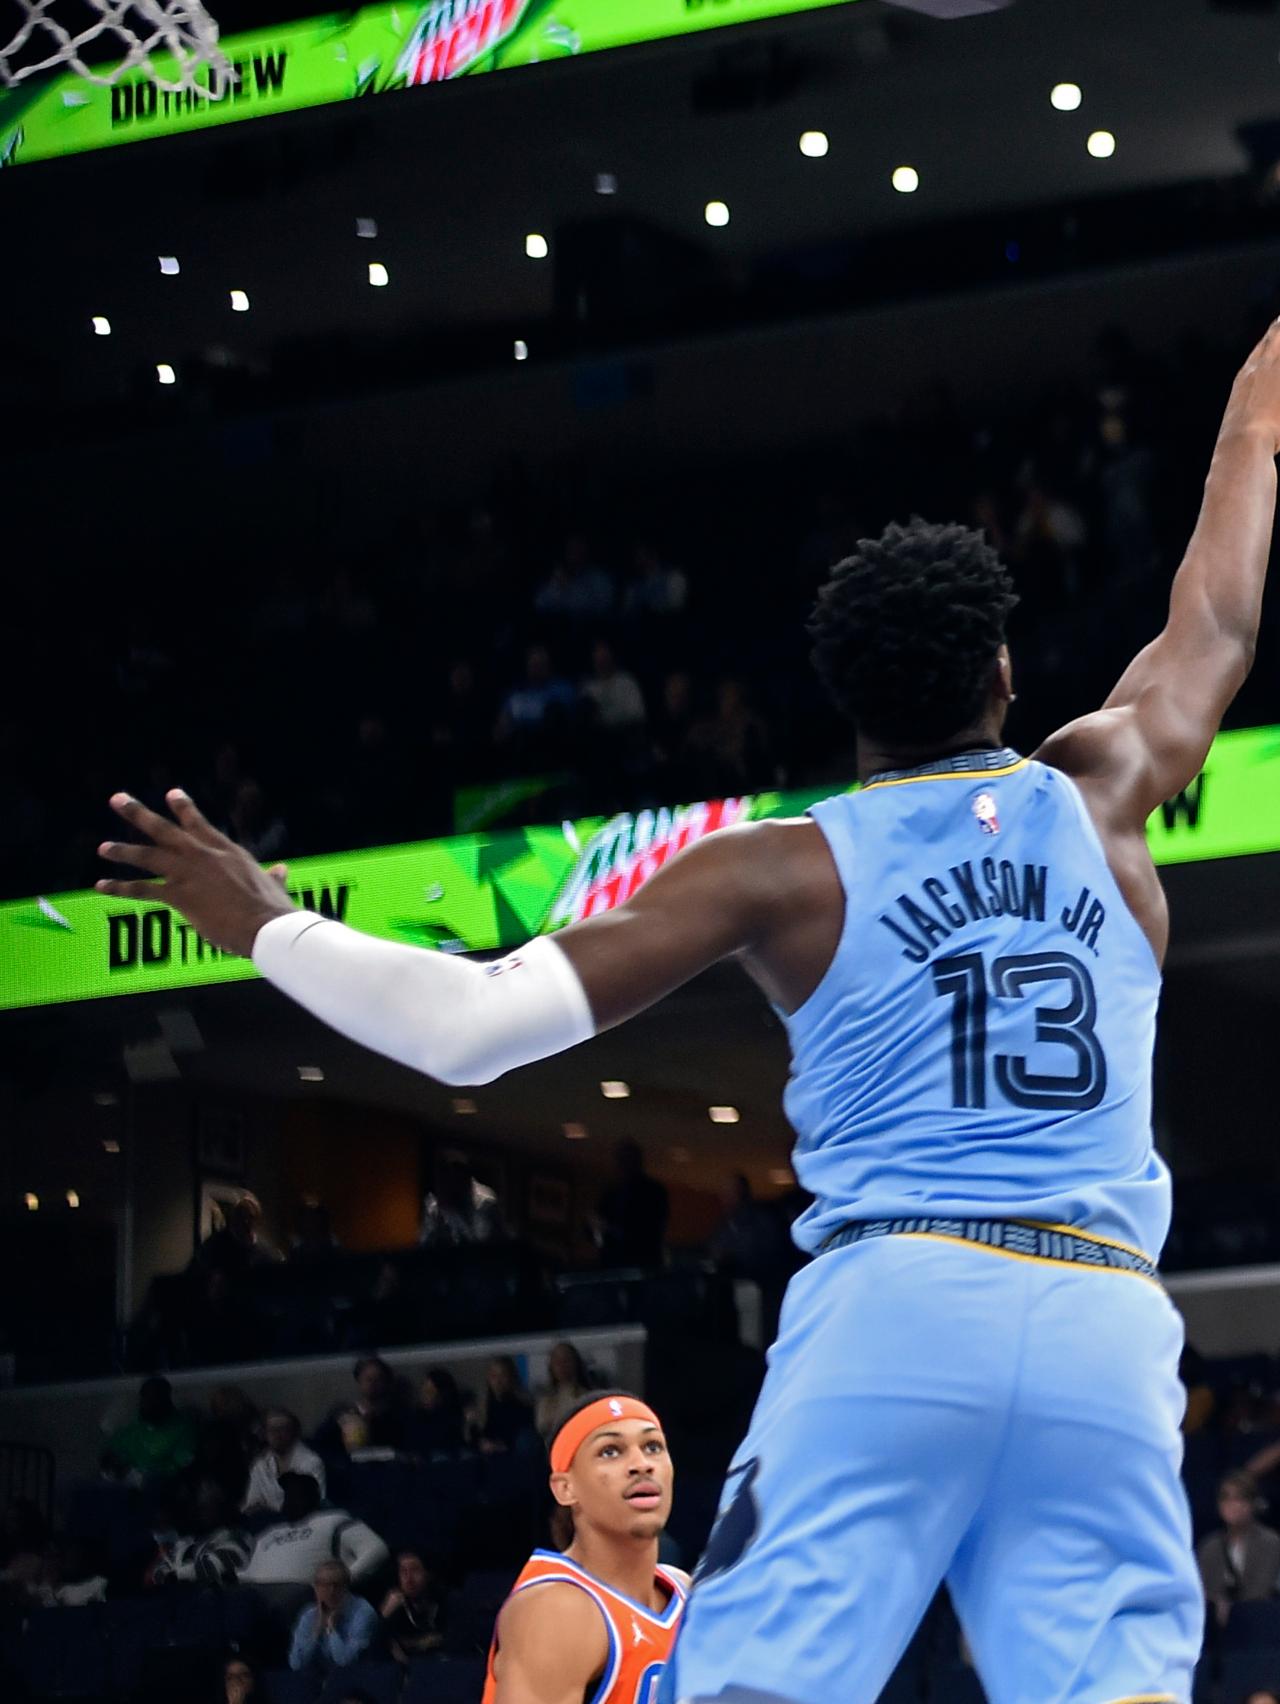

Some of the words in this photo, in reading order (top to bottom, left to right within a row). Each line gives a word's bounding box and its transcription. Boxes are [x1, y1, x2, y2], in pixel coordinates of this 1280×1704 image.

[110, 79, 158, 128] DO
[108, 908, 172, 972] DO
[879, 856, 1048, 963] JACKSON
[932, 951, 1107, 1111] 13
